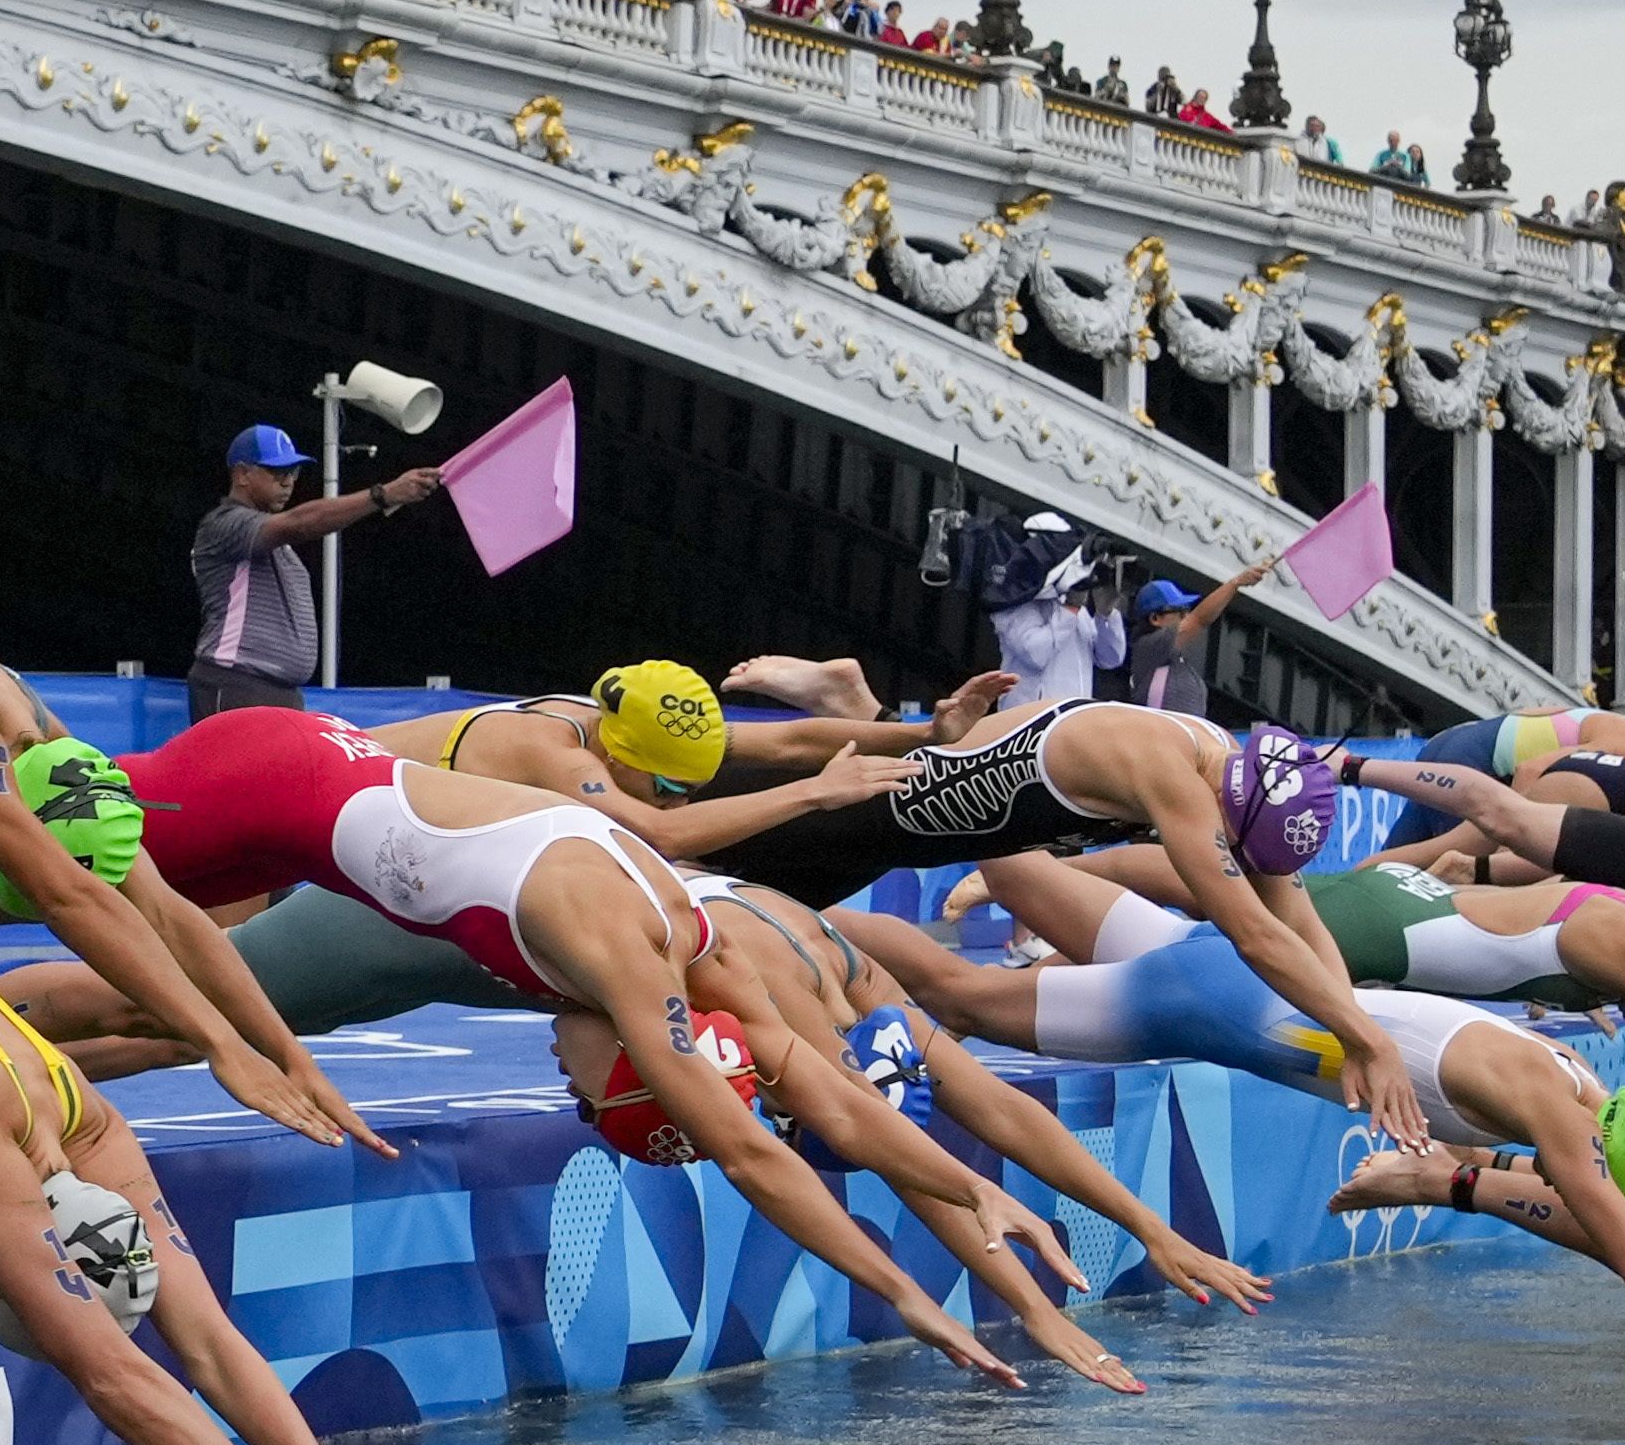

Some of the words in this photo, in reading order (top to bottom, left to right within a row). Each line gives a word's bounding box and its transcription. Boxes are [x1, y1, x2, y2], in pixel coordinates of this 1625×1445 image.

[659, 694, 707, 717] COL
[1416, 770, 1457, 790] 52
[663, 995, 697, 1055] 28
[44, 1228, 92, 1302] 14
